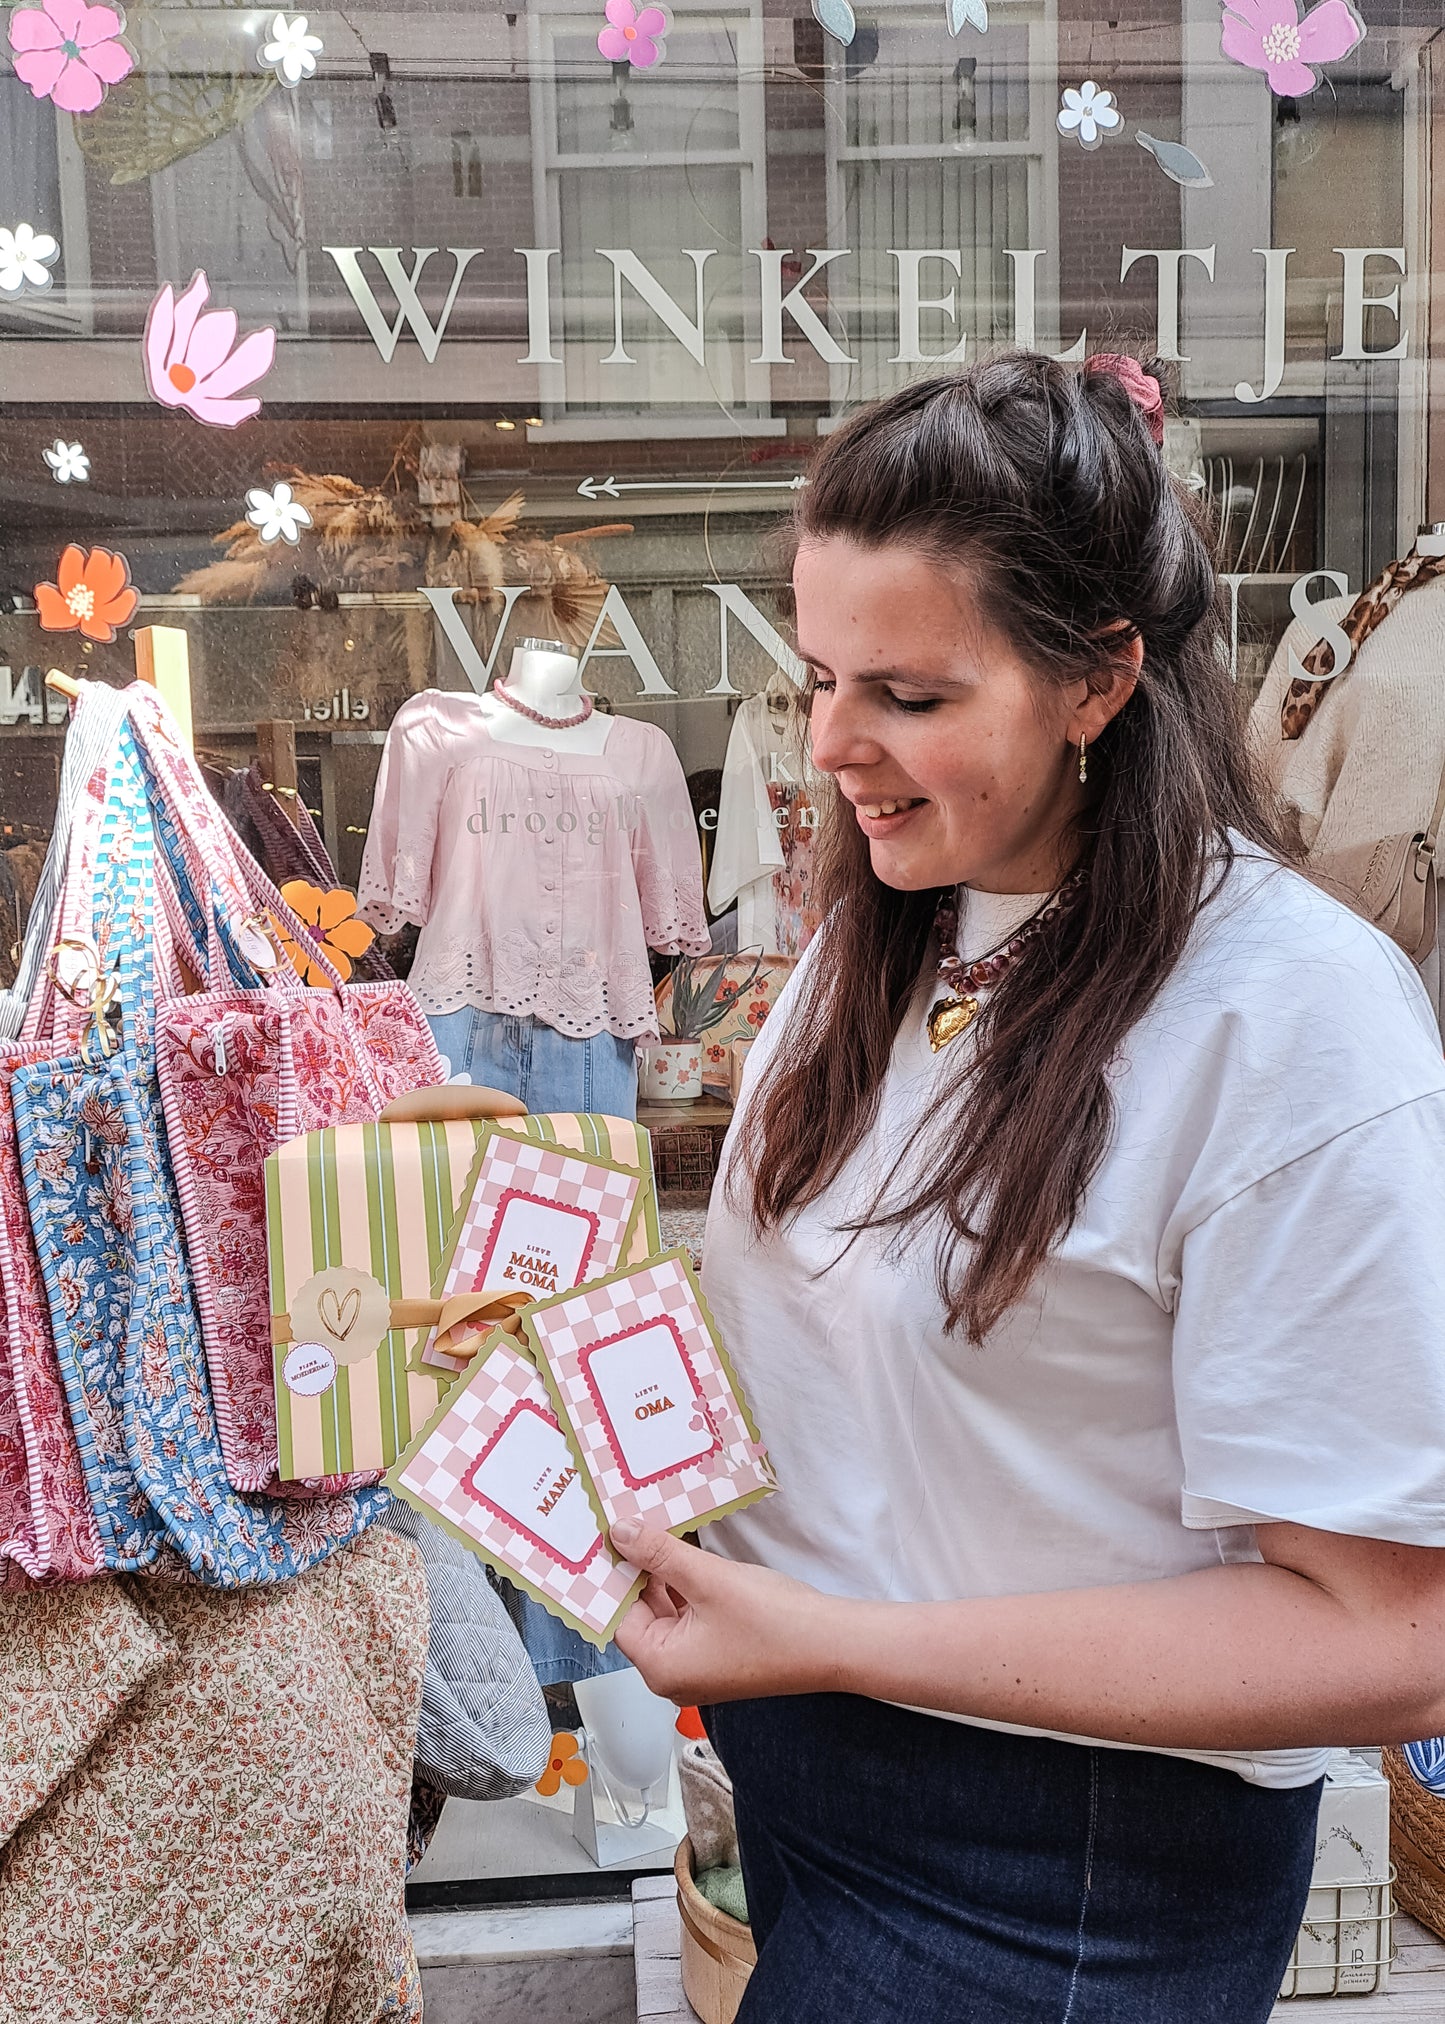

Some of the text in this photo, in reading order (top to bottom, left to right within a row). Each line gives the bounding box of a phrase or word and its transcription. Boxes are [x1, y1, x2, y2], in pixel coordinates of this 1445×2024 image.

[321, 245, 1410, 404] WINKELTJE
[526, 1244, 552, 1257] LIEVE
[508, 1251, 560, 1278] MAMA
[502, 1265, 557, 1293] & OMA
[634, 1384, 659, 1399] LIEVE
[634, 1395, 676, 1421] OMA
[532, 1466, 552, 1492] LIEVE
[536, 1467, 579, 1517] MAMA
